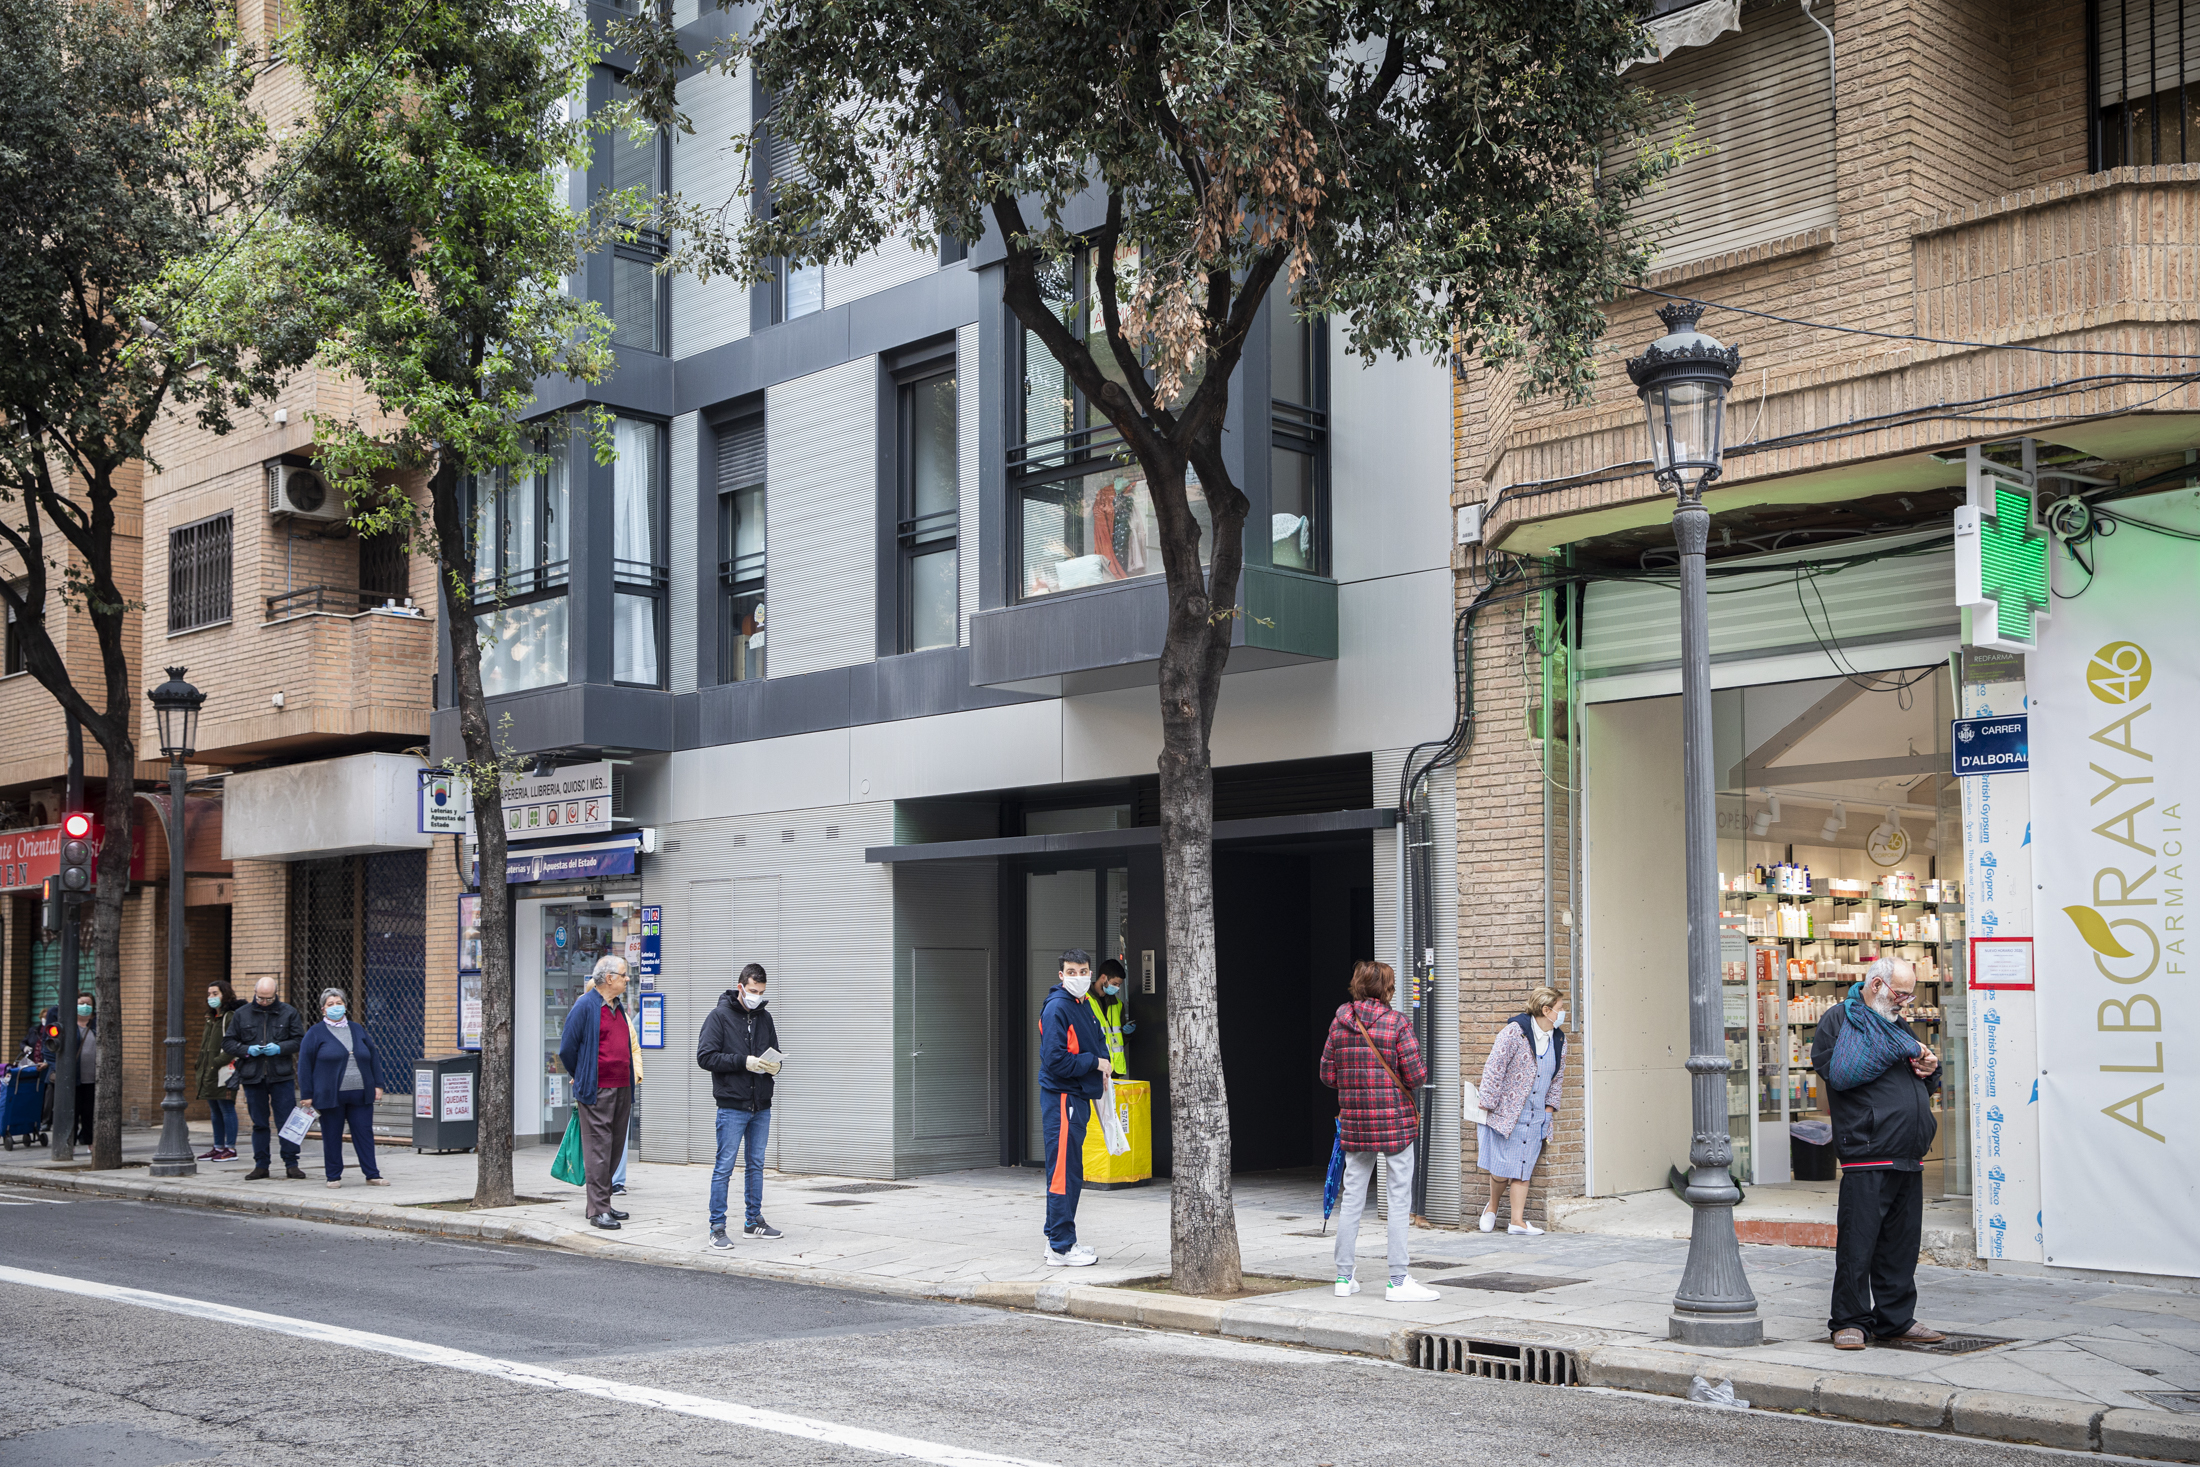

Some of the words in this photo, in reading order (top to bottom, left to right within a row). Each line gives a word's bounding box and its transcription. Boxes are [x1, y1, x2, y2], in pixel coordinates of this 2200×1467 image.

[1974, 653, 2014, 662] REDFARMA
[2090, 645, 2142, 703] 46
[1981, 724, 2022, 736] CARRER
[563, 779, 585, 794] QUIOSC
[1981, 804, 1990, 843] Gypsum
[17, 830, 62, 858] Oriental
[543, 861, 568, 873] Apuestas
[568, 859, 577, 868] del
[578, 857, 597, 868] Estado
[1985, 868, 1994, 902] Gyproc
[2162, 802, 2186, 974] FARMACIA
[2088, 702, 2166, 1145] ALBORAYA
[1988, 1025, 1997, 1055] British
[1986, 1057, 1997, 1097] Gypsum
[1991, 1123, 2001, 1157] Gyproc
[1994, 1230, 2004, 1258] Rigips
